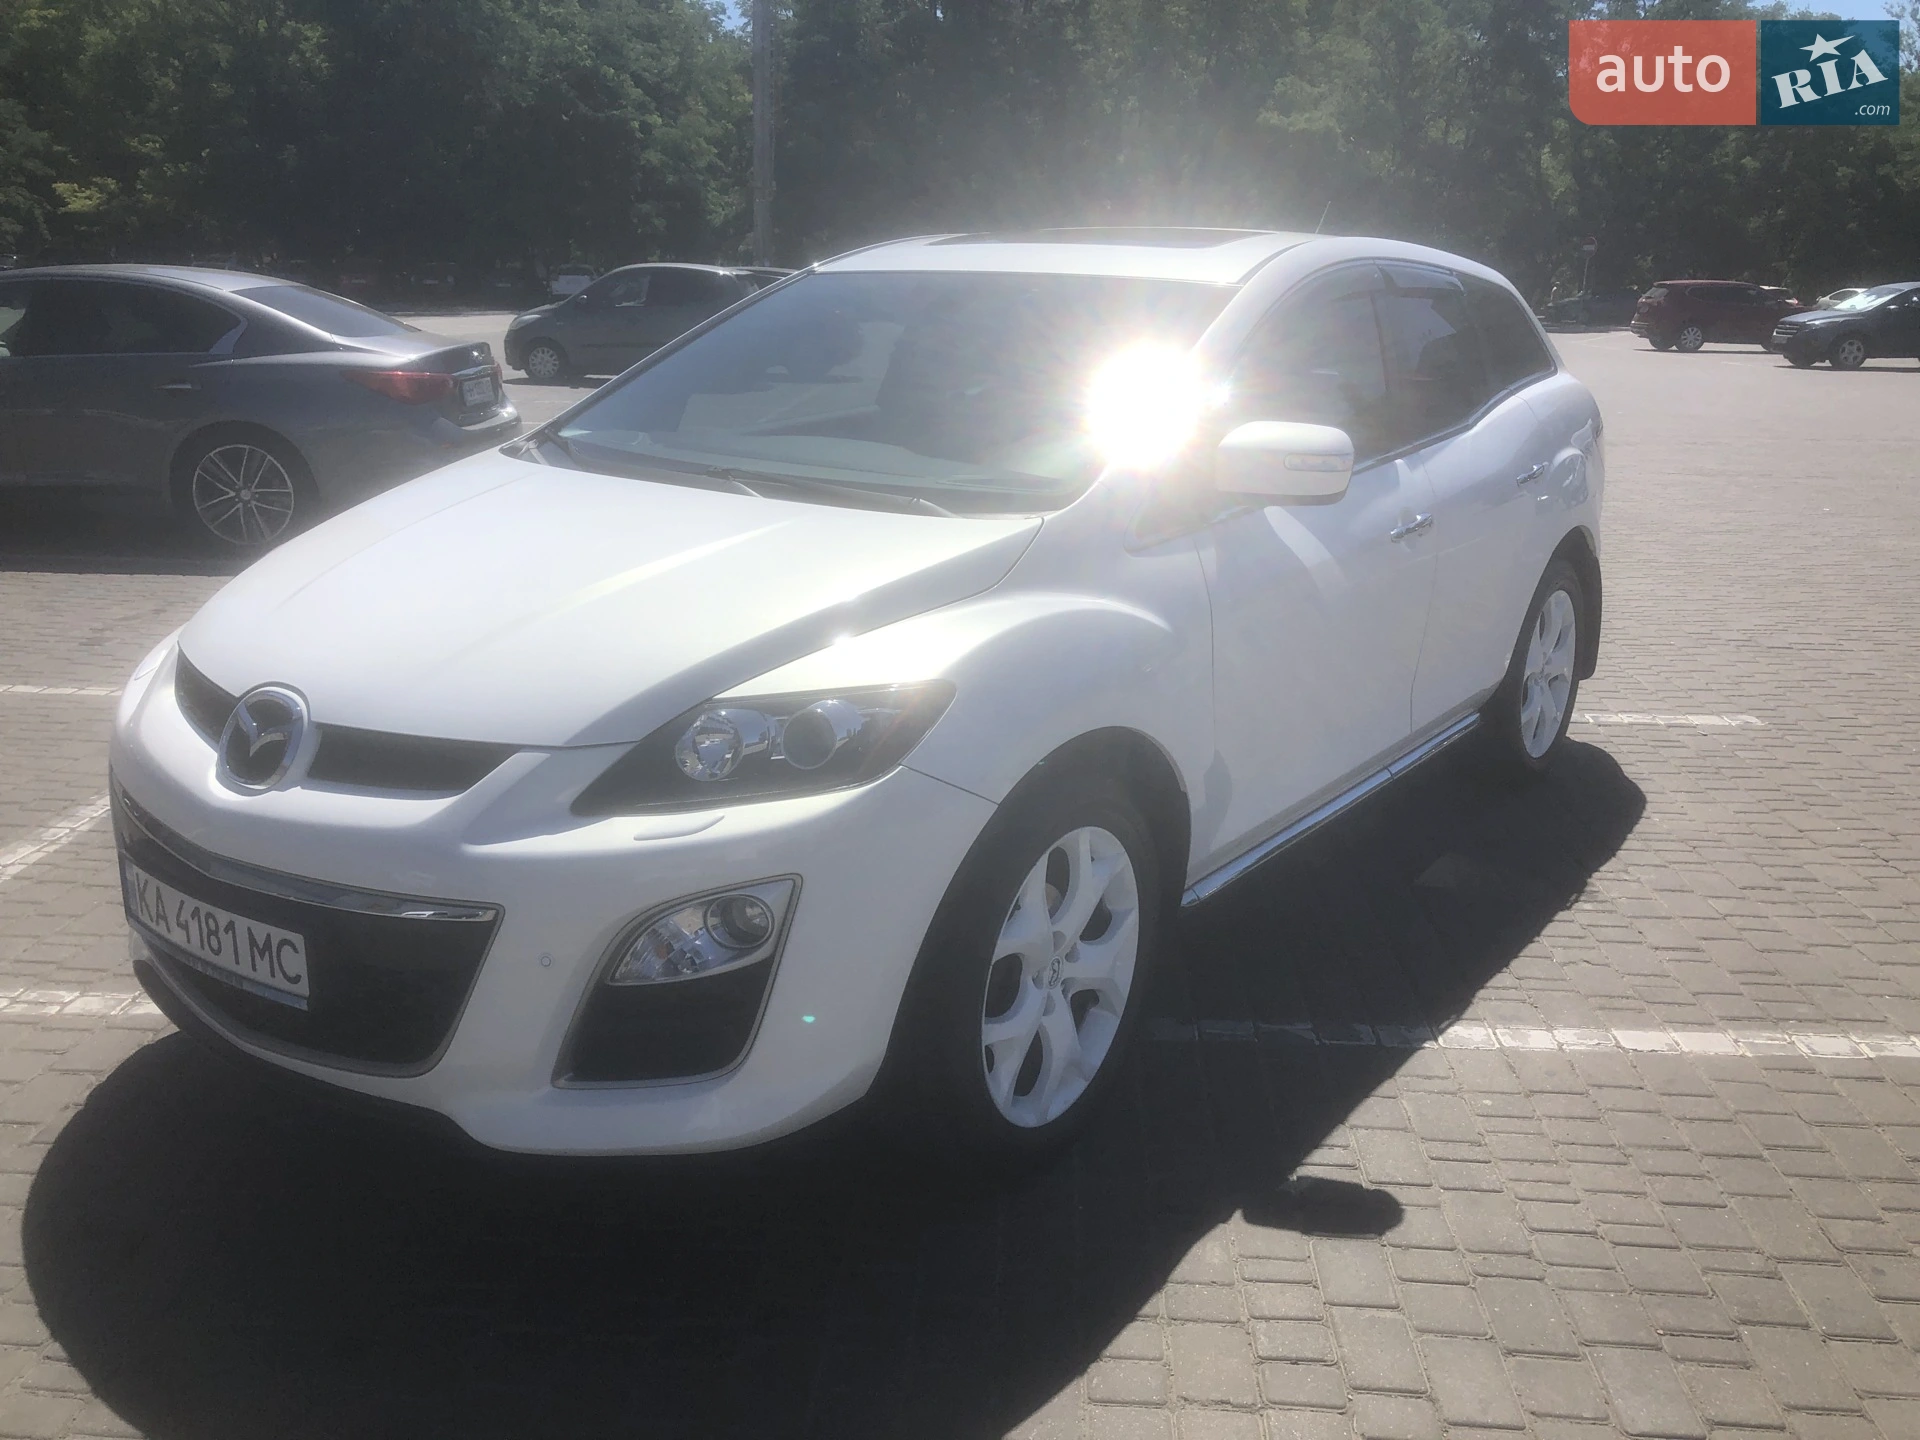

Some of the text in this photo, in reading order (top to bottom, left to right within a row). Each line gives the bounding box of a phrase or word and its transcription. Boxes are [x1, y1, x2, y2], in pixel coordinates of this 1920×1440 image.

[136, 872, 302, 984] KA 4181 MC
